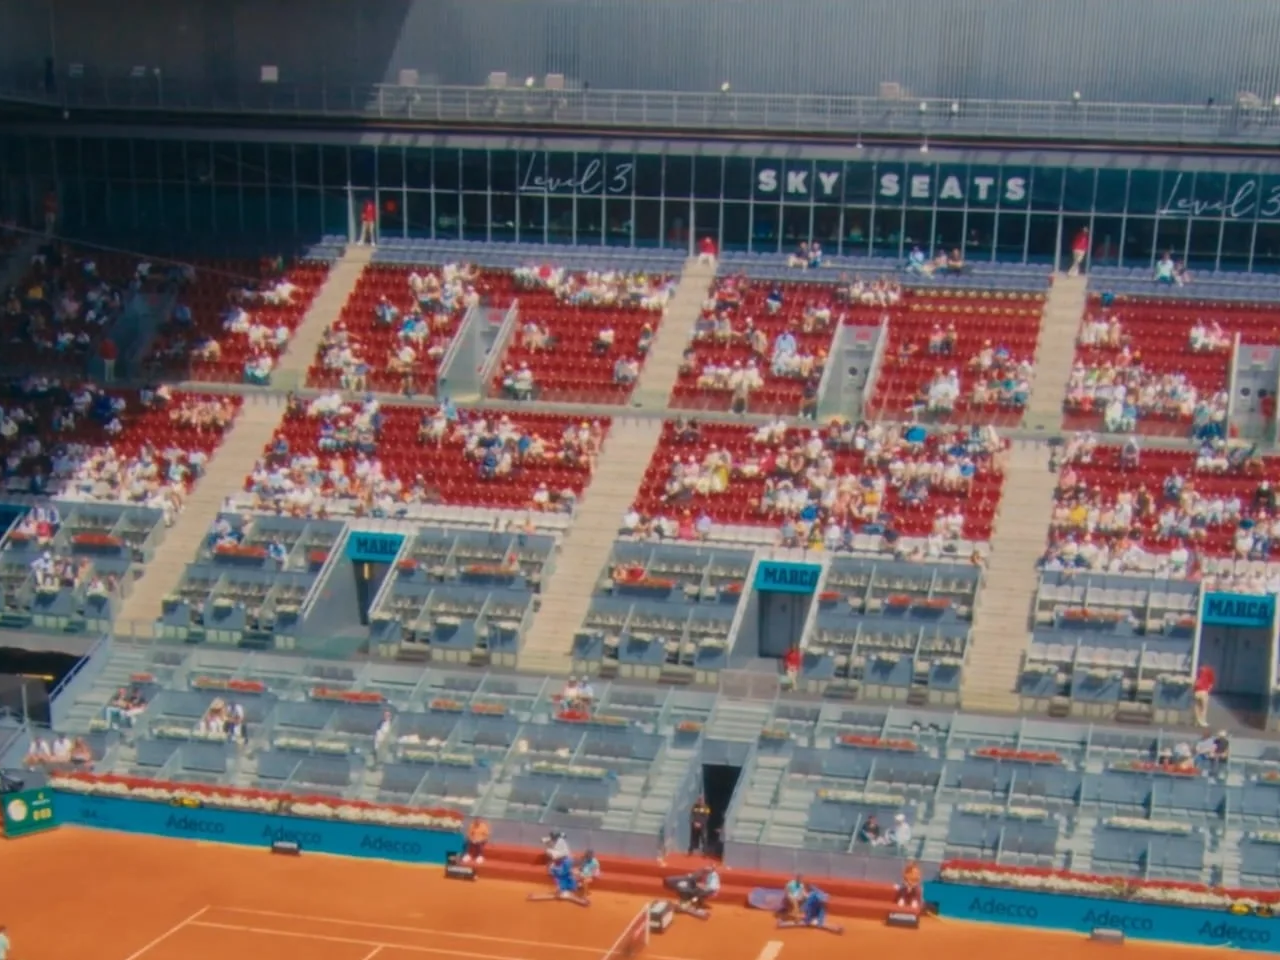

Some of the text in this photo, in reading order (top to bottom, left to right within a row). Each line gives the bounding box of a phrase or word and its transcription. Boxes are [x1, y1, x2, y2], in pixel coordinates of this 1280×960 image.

[519, 152, 633, 193] Level 3
[758, 168, 1026, 200] SKY SEATS
[1158, 172, 1255, 217] Level
[356, 537, 402, 555] MARC
[166, 814, 225, 834] Adecco
[361, 834, 422, 855] Adecco
[968, 897, 1038, 919] Adecco
[1082, 908, 1153, 931] Adecco
[1199, 921, 1271, 944] Adecco
